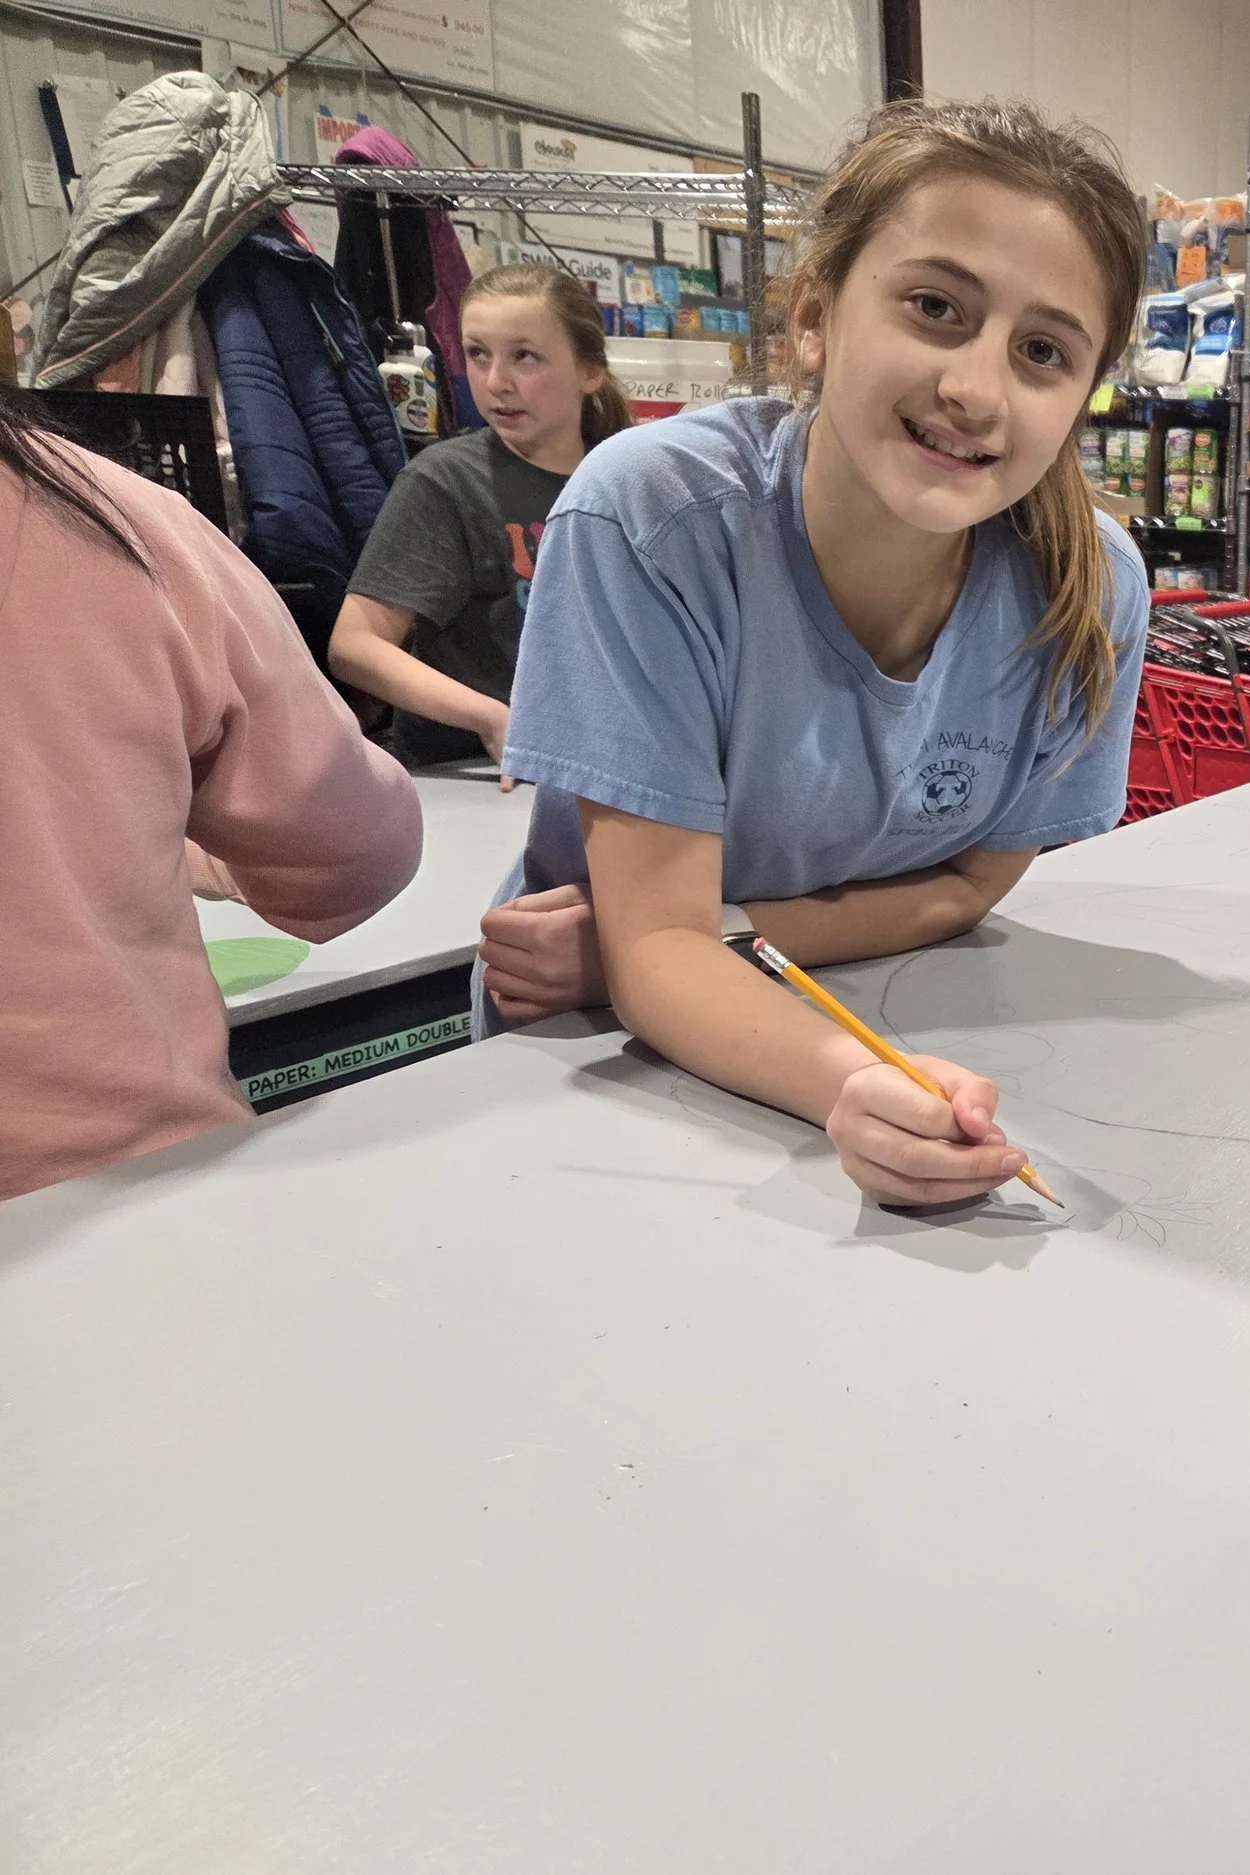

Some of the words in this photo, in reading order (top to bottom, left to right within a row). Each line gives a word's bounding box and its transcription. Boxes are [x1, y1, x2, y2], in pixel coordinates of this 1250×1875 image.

[569, 259, 611, 281] Guide
[625, 382, 679, 399] PAPER
[918, 758, 981, 781] TRITON
[914, 803, 972, 824] SOCCER
[248, 1066, 316, 1097] PAPER:
[325, 1038, 400, 1073] MEDIUM
[406, 1016, 471, 1047] DOUBLE
